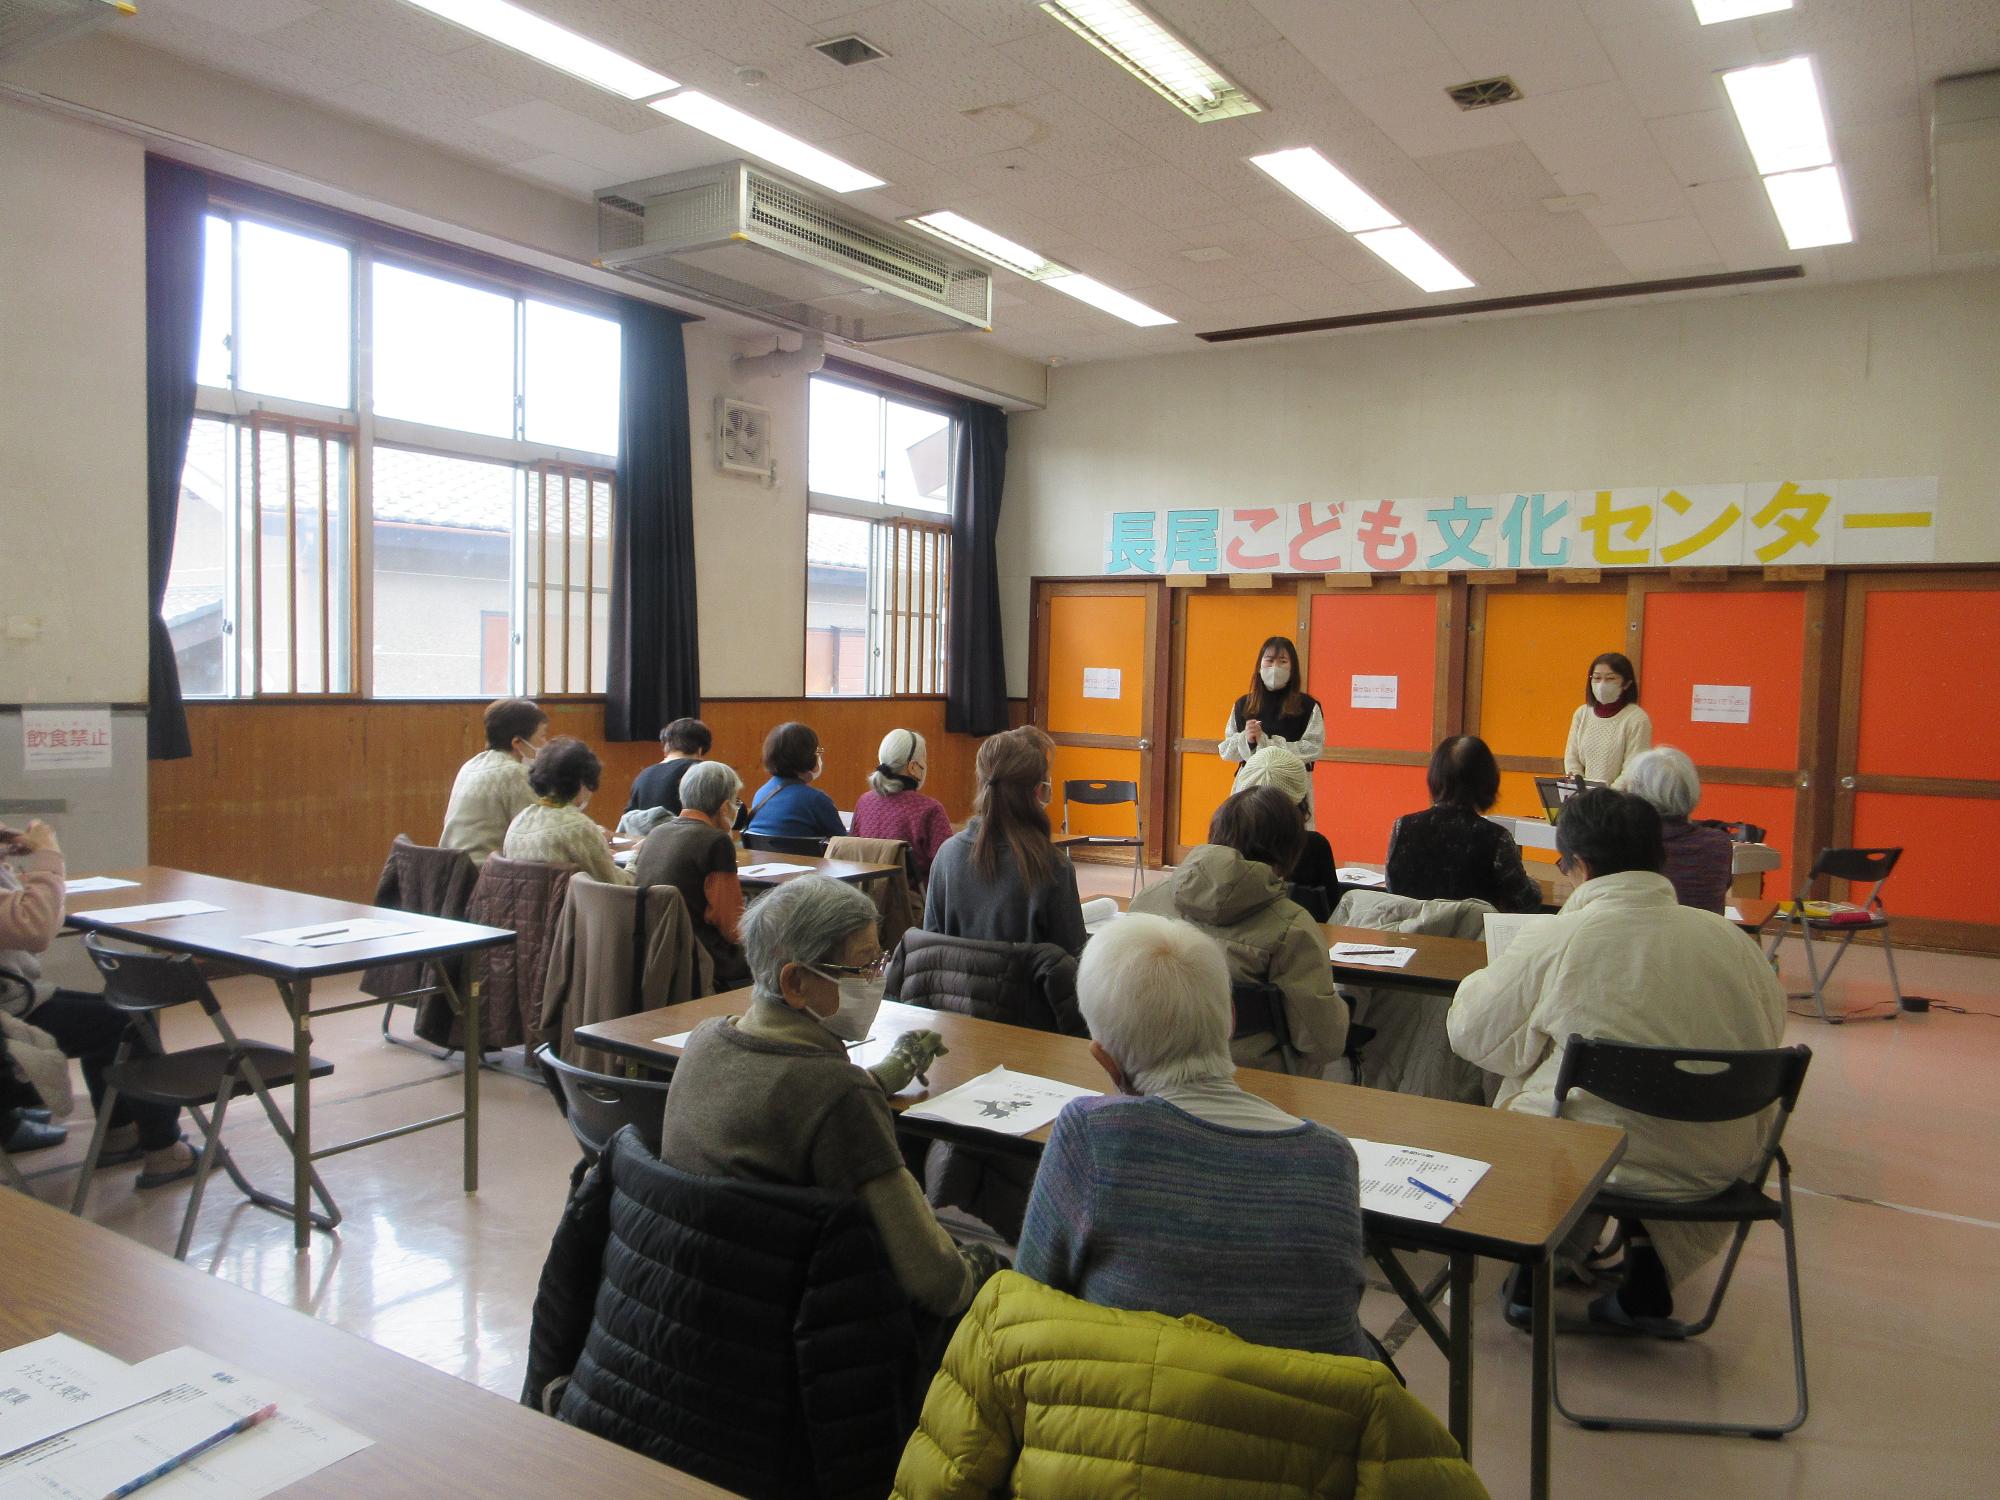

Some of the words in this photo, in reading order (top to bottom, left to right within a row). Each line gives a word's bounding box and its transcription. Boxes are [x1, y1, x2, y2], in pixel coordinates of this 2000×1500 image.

[1105, 480, 1932, 574] 長尾こども文化センター
[26, 728, 109, 748] 飲食禁止
